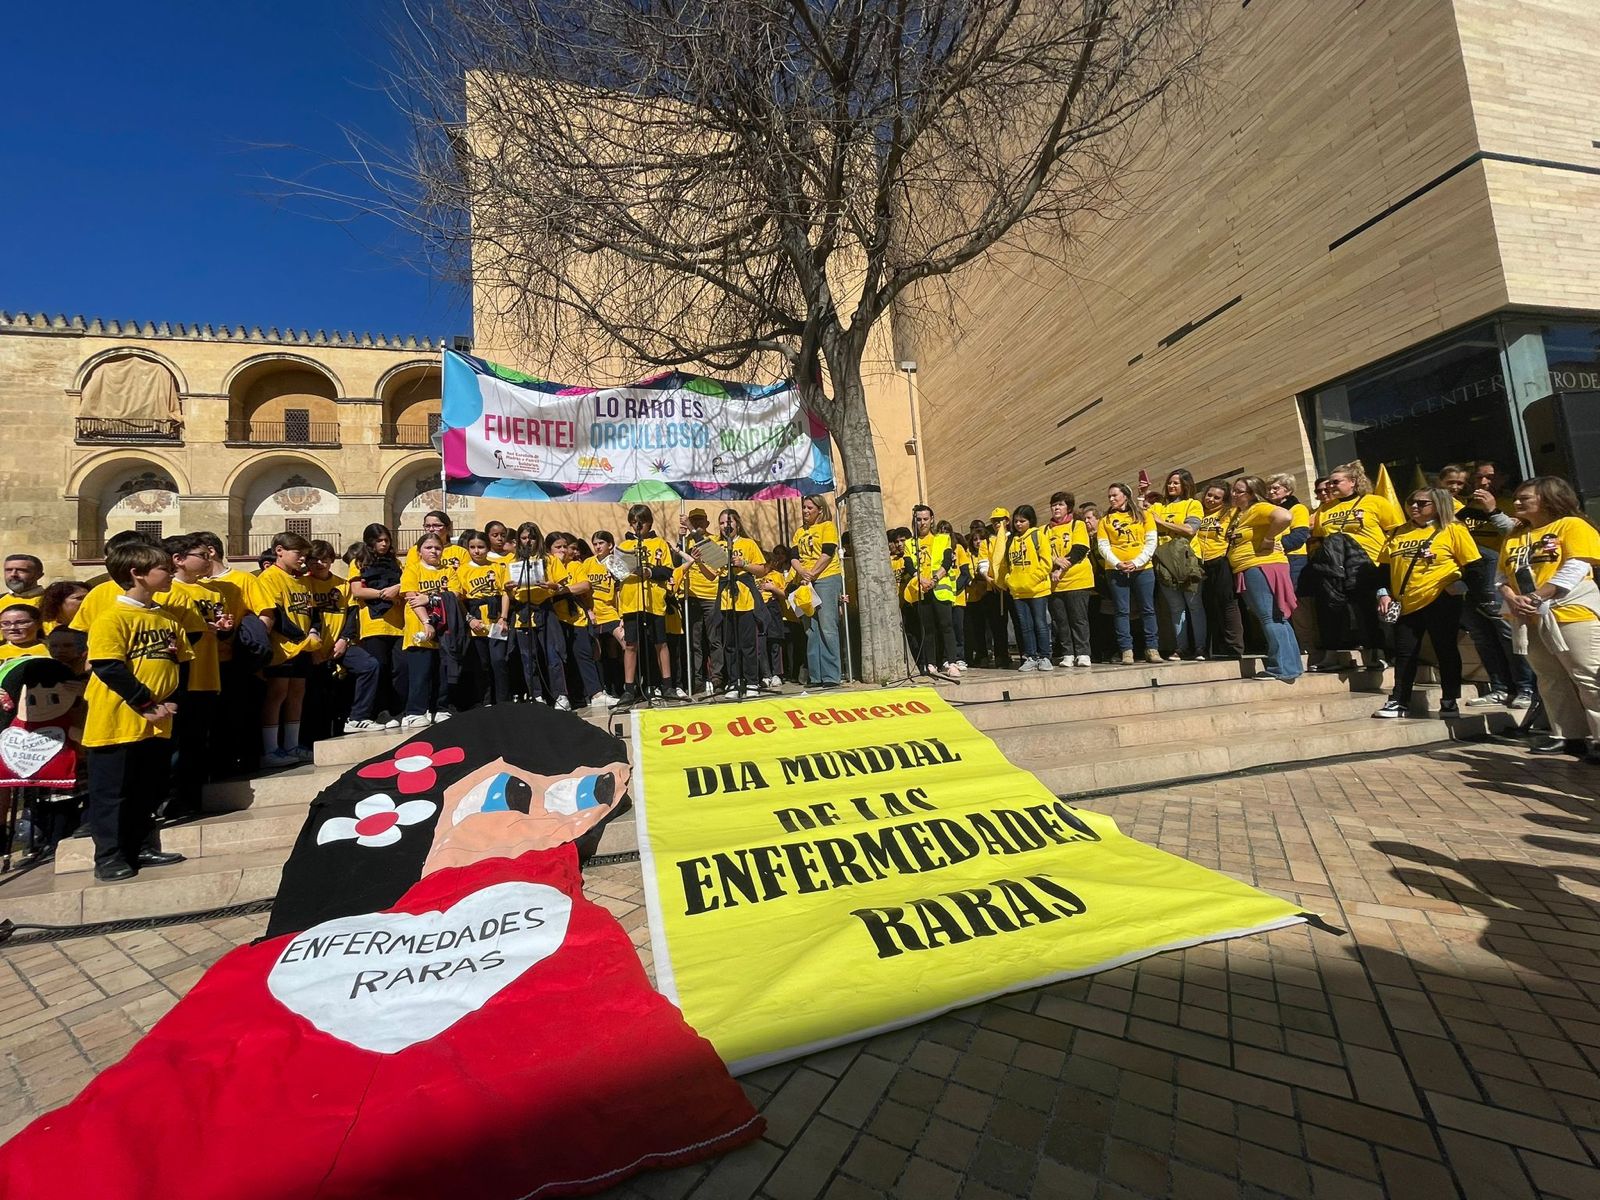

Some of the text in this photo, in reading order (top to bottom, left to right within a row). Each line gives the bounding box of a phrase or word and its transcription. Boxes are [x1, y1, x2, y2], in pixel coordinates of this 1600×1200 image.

[484, 414, 574, 448] FUERTE!
[595, 396, 704, 419] LO RARO ES
[590, 422, 710, 450] ORGULLOSO!
[659, 700, 932, 746] 29 de Febrero
[683, 737, 962, 798] DIA MUNDIAL
[773, 787, 940, 834] DE LAS
[676, 802, 1102, 916] ENFERMEDADES
[279, 906, 546, 965] ENFERMEDADES
[850, 873, 1088, 959] RARAS
[349, 950, 506, 1000] RARAS
